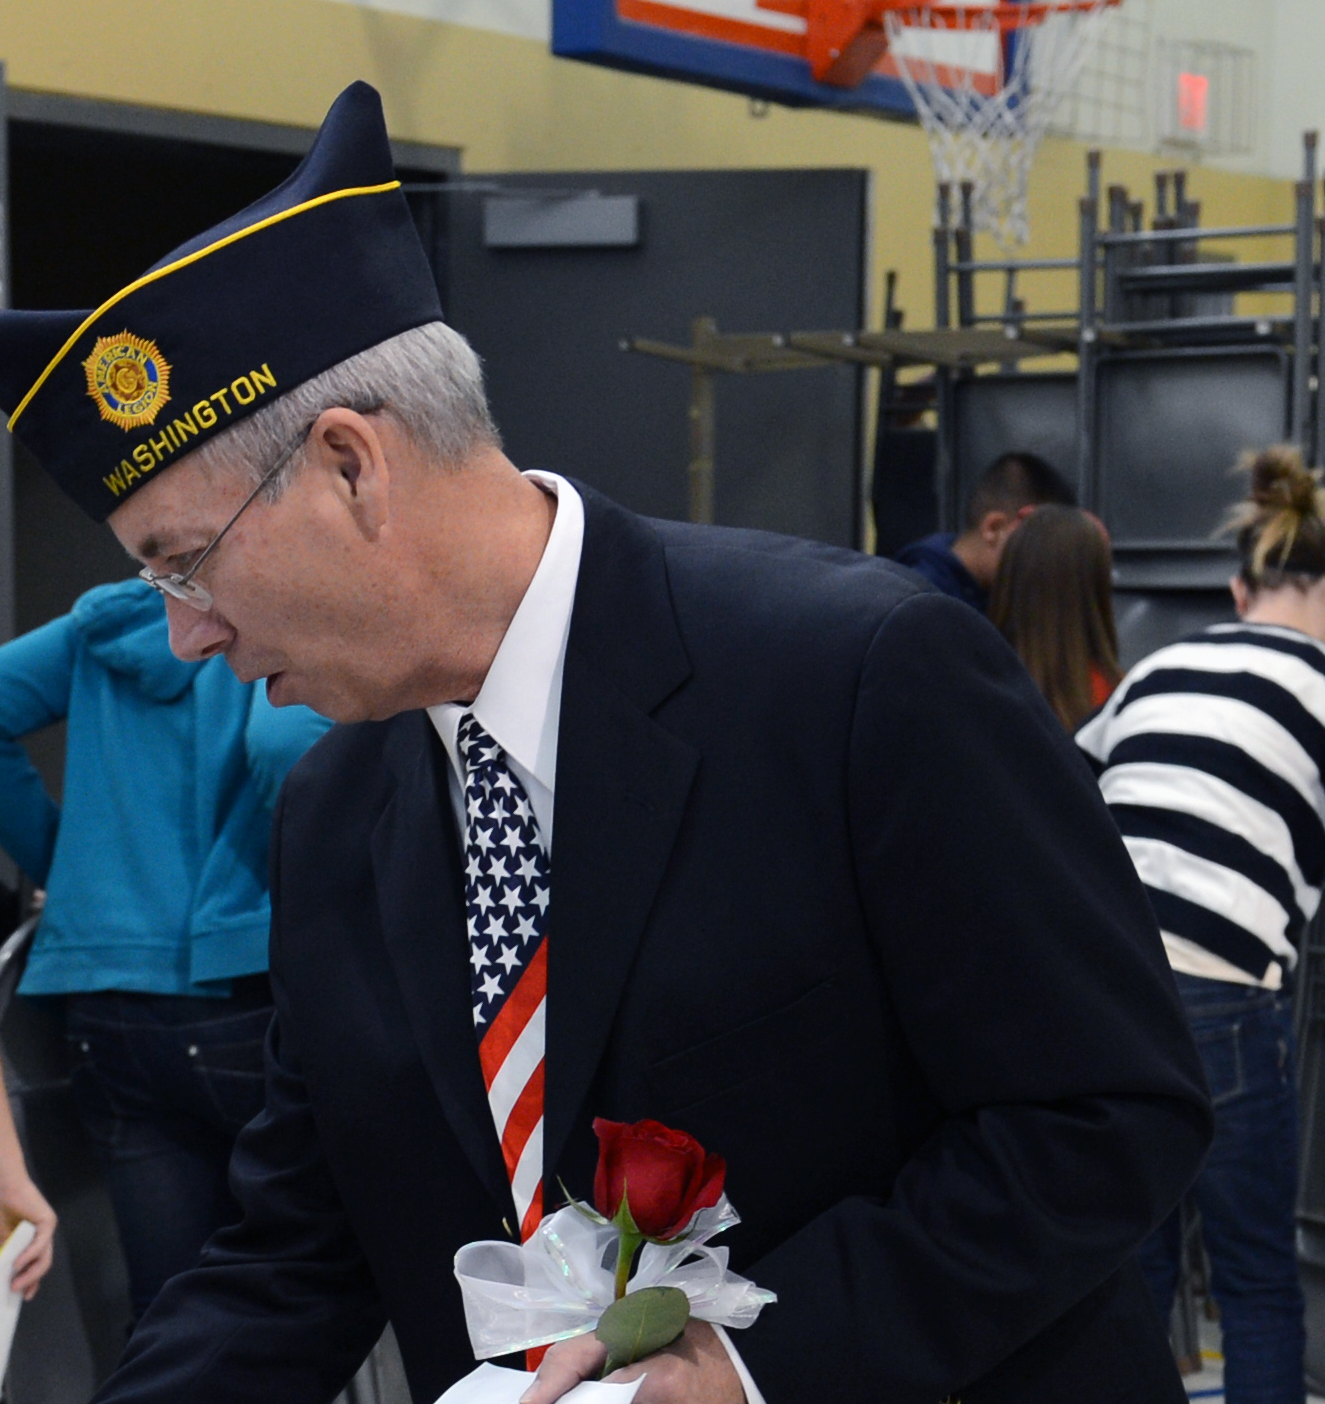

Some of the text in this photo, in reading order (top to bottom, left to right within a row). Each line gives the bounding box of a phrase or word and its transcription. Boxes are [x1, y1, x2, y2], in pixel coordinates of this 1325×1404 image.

[96, 345, 148, 393] AMERICAN
[115, 381, 158, 415] LEGION
[103, 363, 277, 496] WASHINGTON
